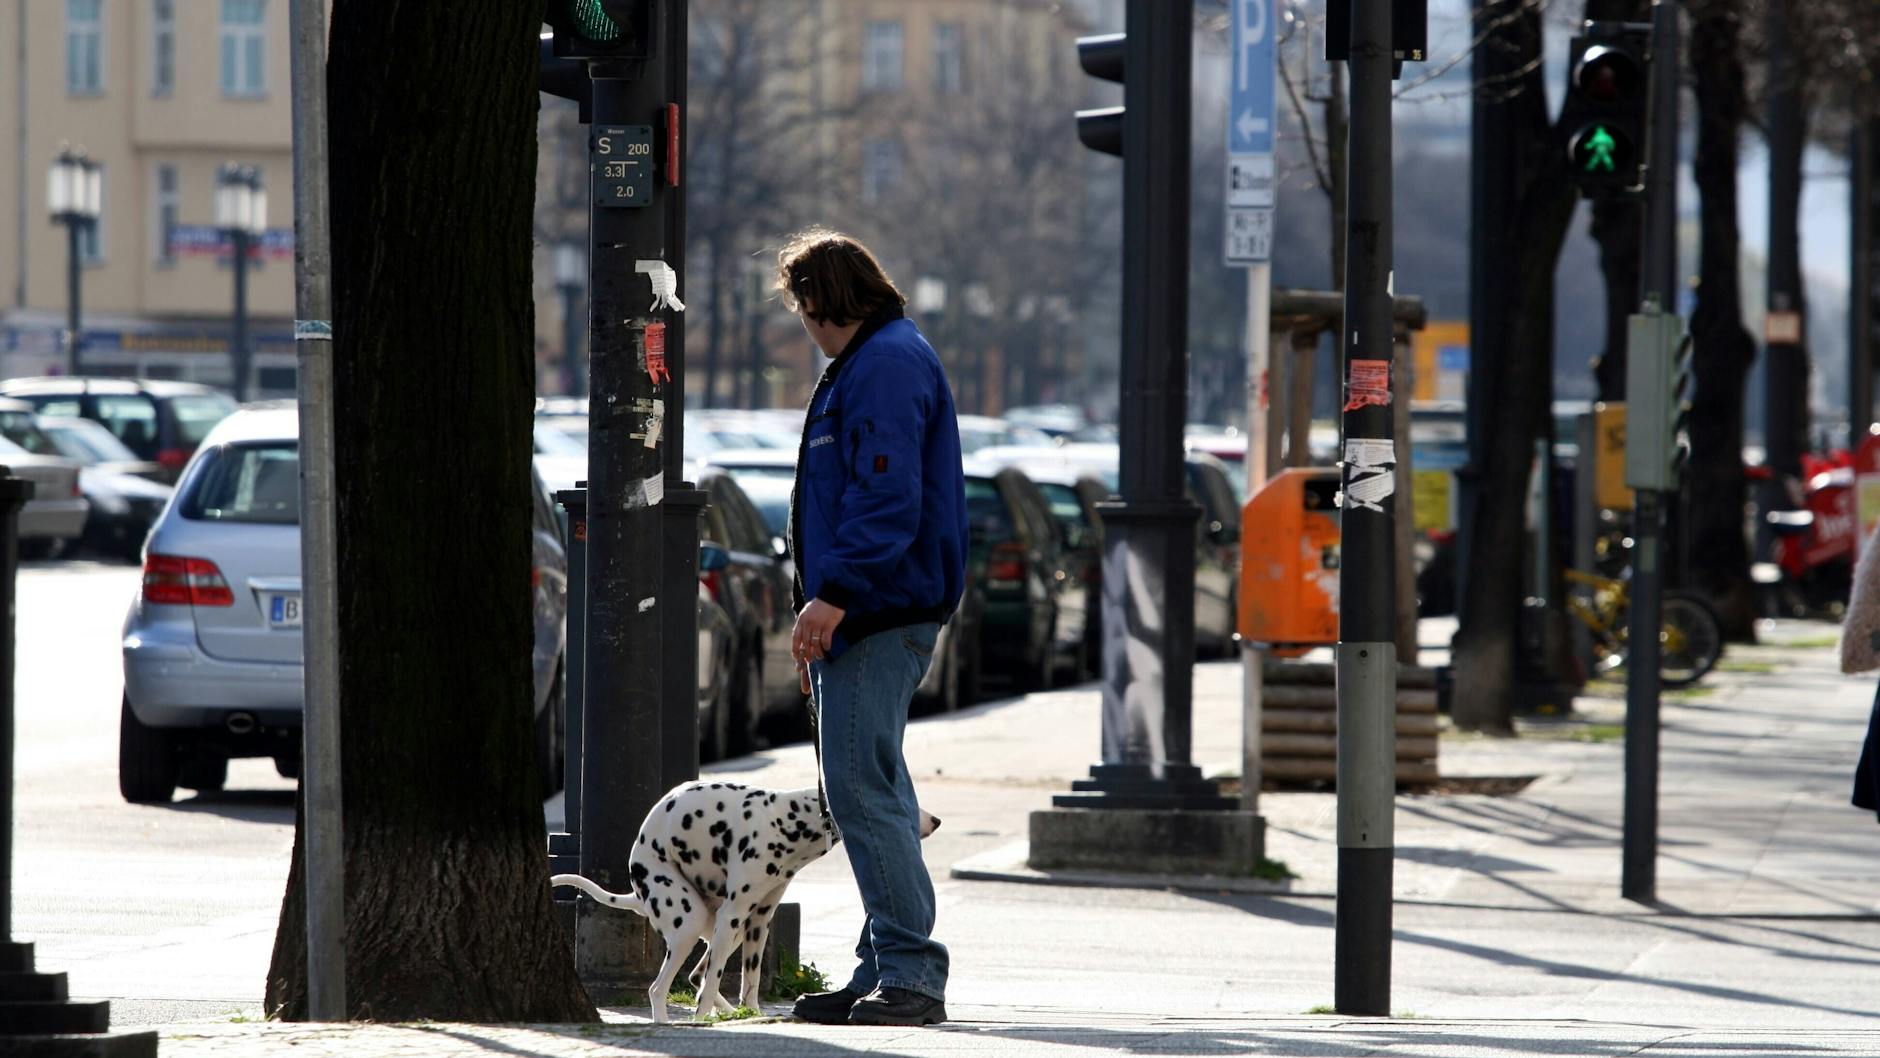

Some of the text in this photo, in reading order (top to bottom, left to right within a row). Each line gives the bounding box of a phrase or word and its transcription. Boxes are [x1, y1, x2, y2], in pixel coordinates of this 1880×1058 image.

[1237, 0, 1267, 92] P
[598, 137, 650, 156] S 200
